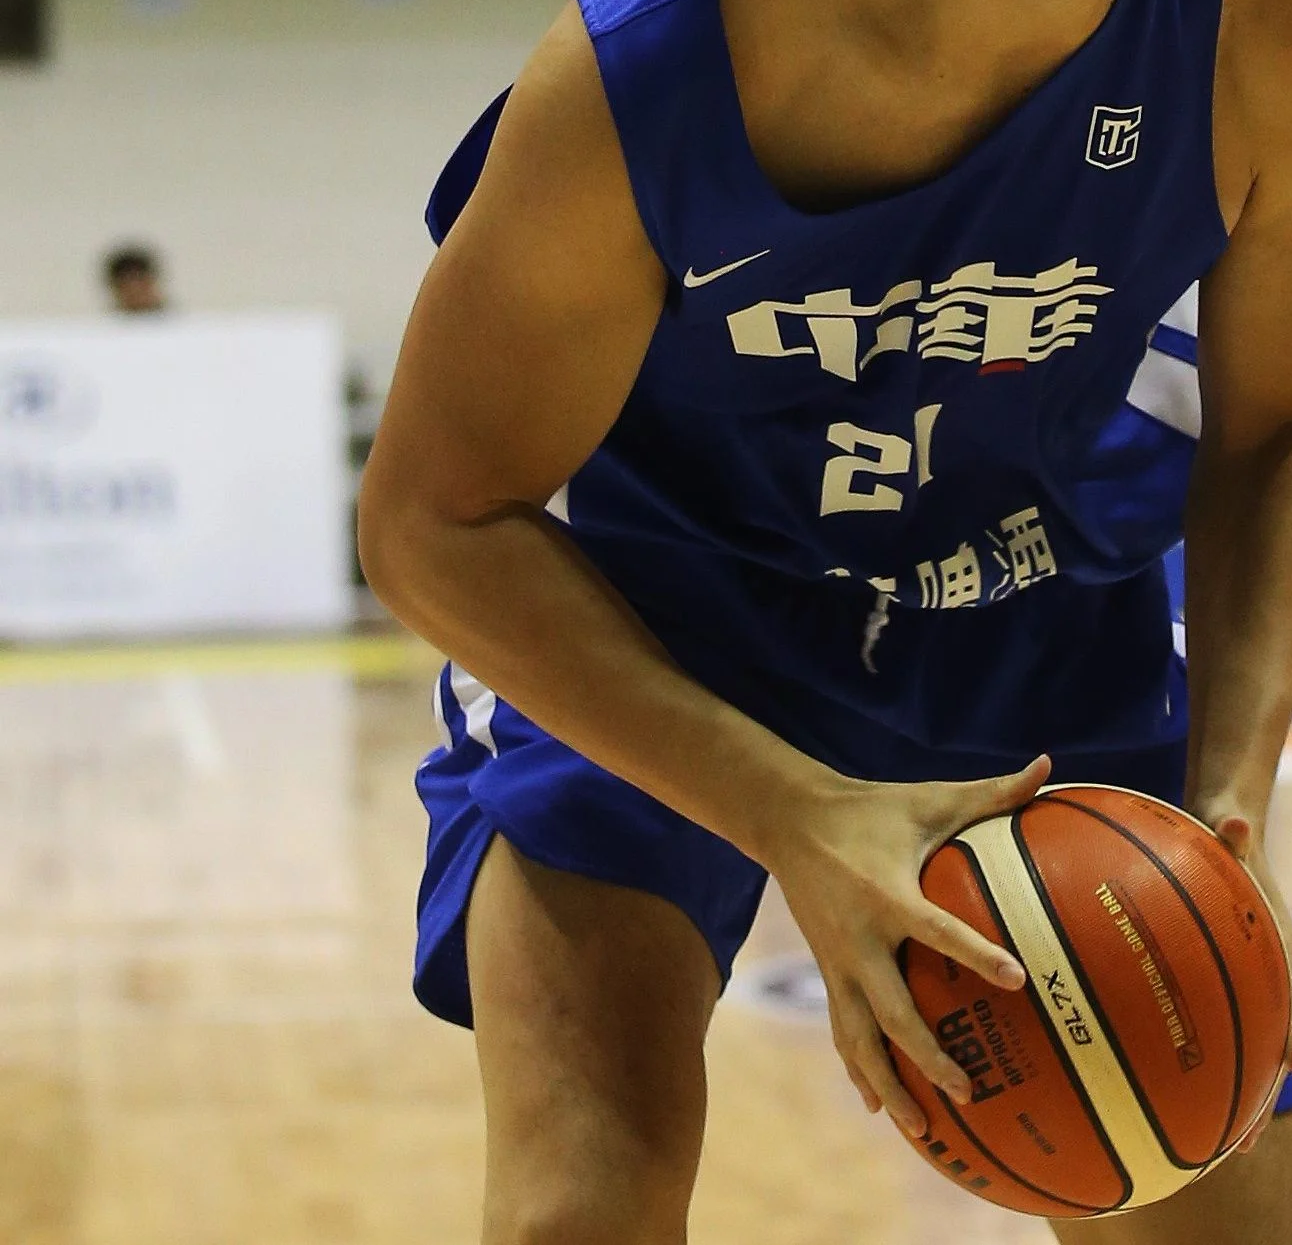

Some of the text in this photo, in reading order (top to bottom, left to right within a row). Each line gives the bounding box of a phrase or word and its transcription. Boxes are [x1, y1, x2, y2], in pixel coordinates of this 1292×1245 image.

[726, 257, 1115, 382] 中華
[1094, 882, 1123, 916] BALL
[1115, 913, 1146, 953] GAME
[974, 999, 1025, 1087] APPROVED
[1041, 969, 1093, 1045] GL7X
